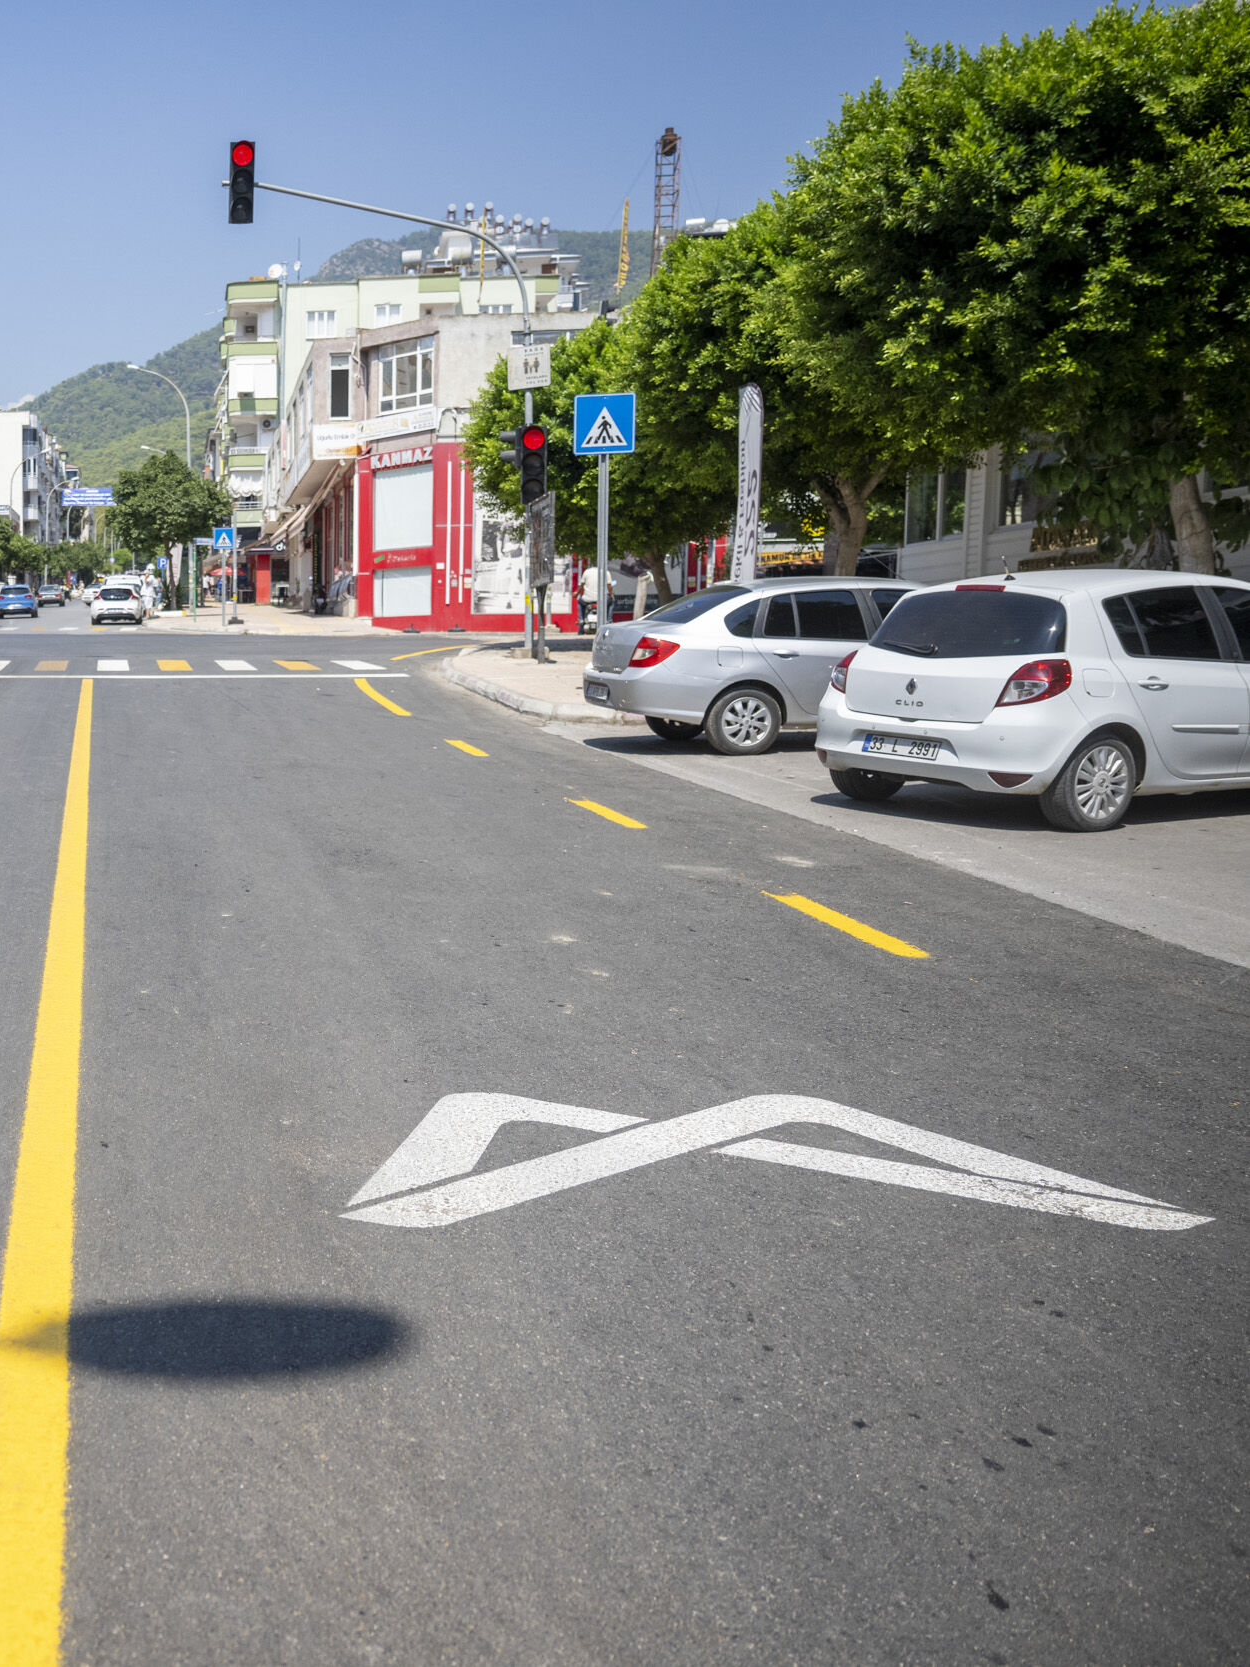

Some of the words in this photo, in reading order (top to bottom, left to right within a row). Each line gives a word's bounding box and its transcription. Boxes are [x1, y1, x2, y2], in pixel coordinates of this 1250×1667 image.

[371, 446, 433, 469] KANMAZ
[895, 699, 924, 707] CLIO
[870, 736, 885, 751] 33
[891, 739, 898, 753] L
[908, 741, 938, 757] 2991
